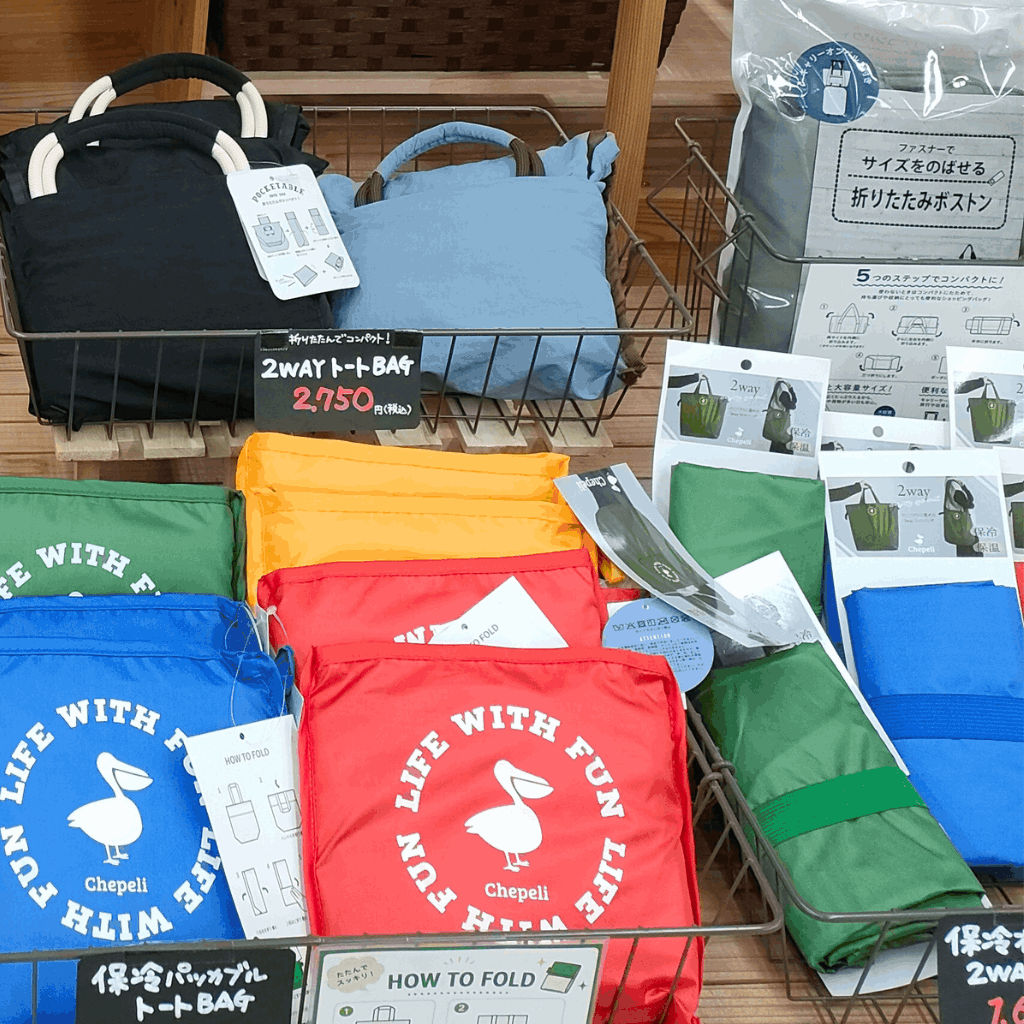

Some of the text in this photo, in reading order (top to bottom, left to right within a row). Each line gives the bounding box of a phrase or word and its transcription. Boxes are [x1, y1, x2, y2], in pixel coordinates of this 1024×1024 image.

[898, 143, 956, 155] ファスナーで
[861, 155, 986, 176] サイズをのばせる
[251, 182, 305, 204] POCKETABLE
[851, 185, 993, 213] 折りたたみボストン
[856, 268, 1005, 284] 5つのステップでコンパクトに！
[288, 332, 390, 346] 折りたたんでコンパクト！
[260, 355, 415, 379] 2WAY トートBAG
[730, 379, 761, 397] 2way
[921, 386, 947, 394] 便利な
[898, 484, 931, 501] 2way
[36, 542, 131, 578] WITH
[907, 546, 935, 554] Chepeli
[479, 624, 500, 643] FOLD
[0, 698, 161, 805] LIFE WITH
[224, 747, 270, 766] HOW TO FOLD
[395, 705, 625, 818] LIFE WITH FUN
[0, 824, 59, 910] FUN
[396, 833, 458, 914] FUN
[85, 876, 149, 897] Chepeli
[575, 837, 626, 925] LIFE
[484, 882, 549, 903] Chepeli
[61, 899, 174, 942] WITH
[91, 960, 268, 997] 保冷パッカブル
[336, 964, 368, 979] たたんで
[336, 971, 375, 987] スッキリ！
[388, 971, 536, 990] HOW TO FOLD
[136, 988, 256, 1022] トートBAG
